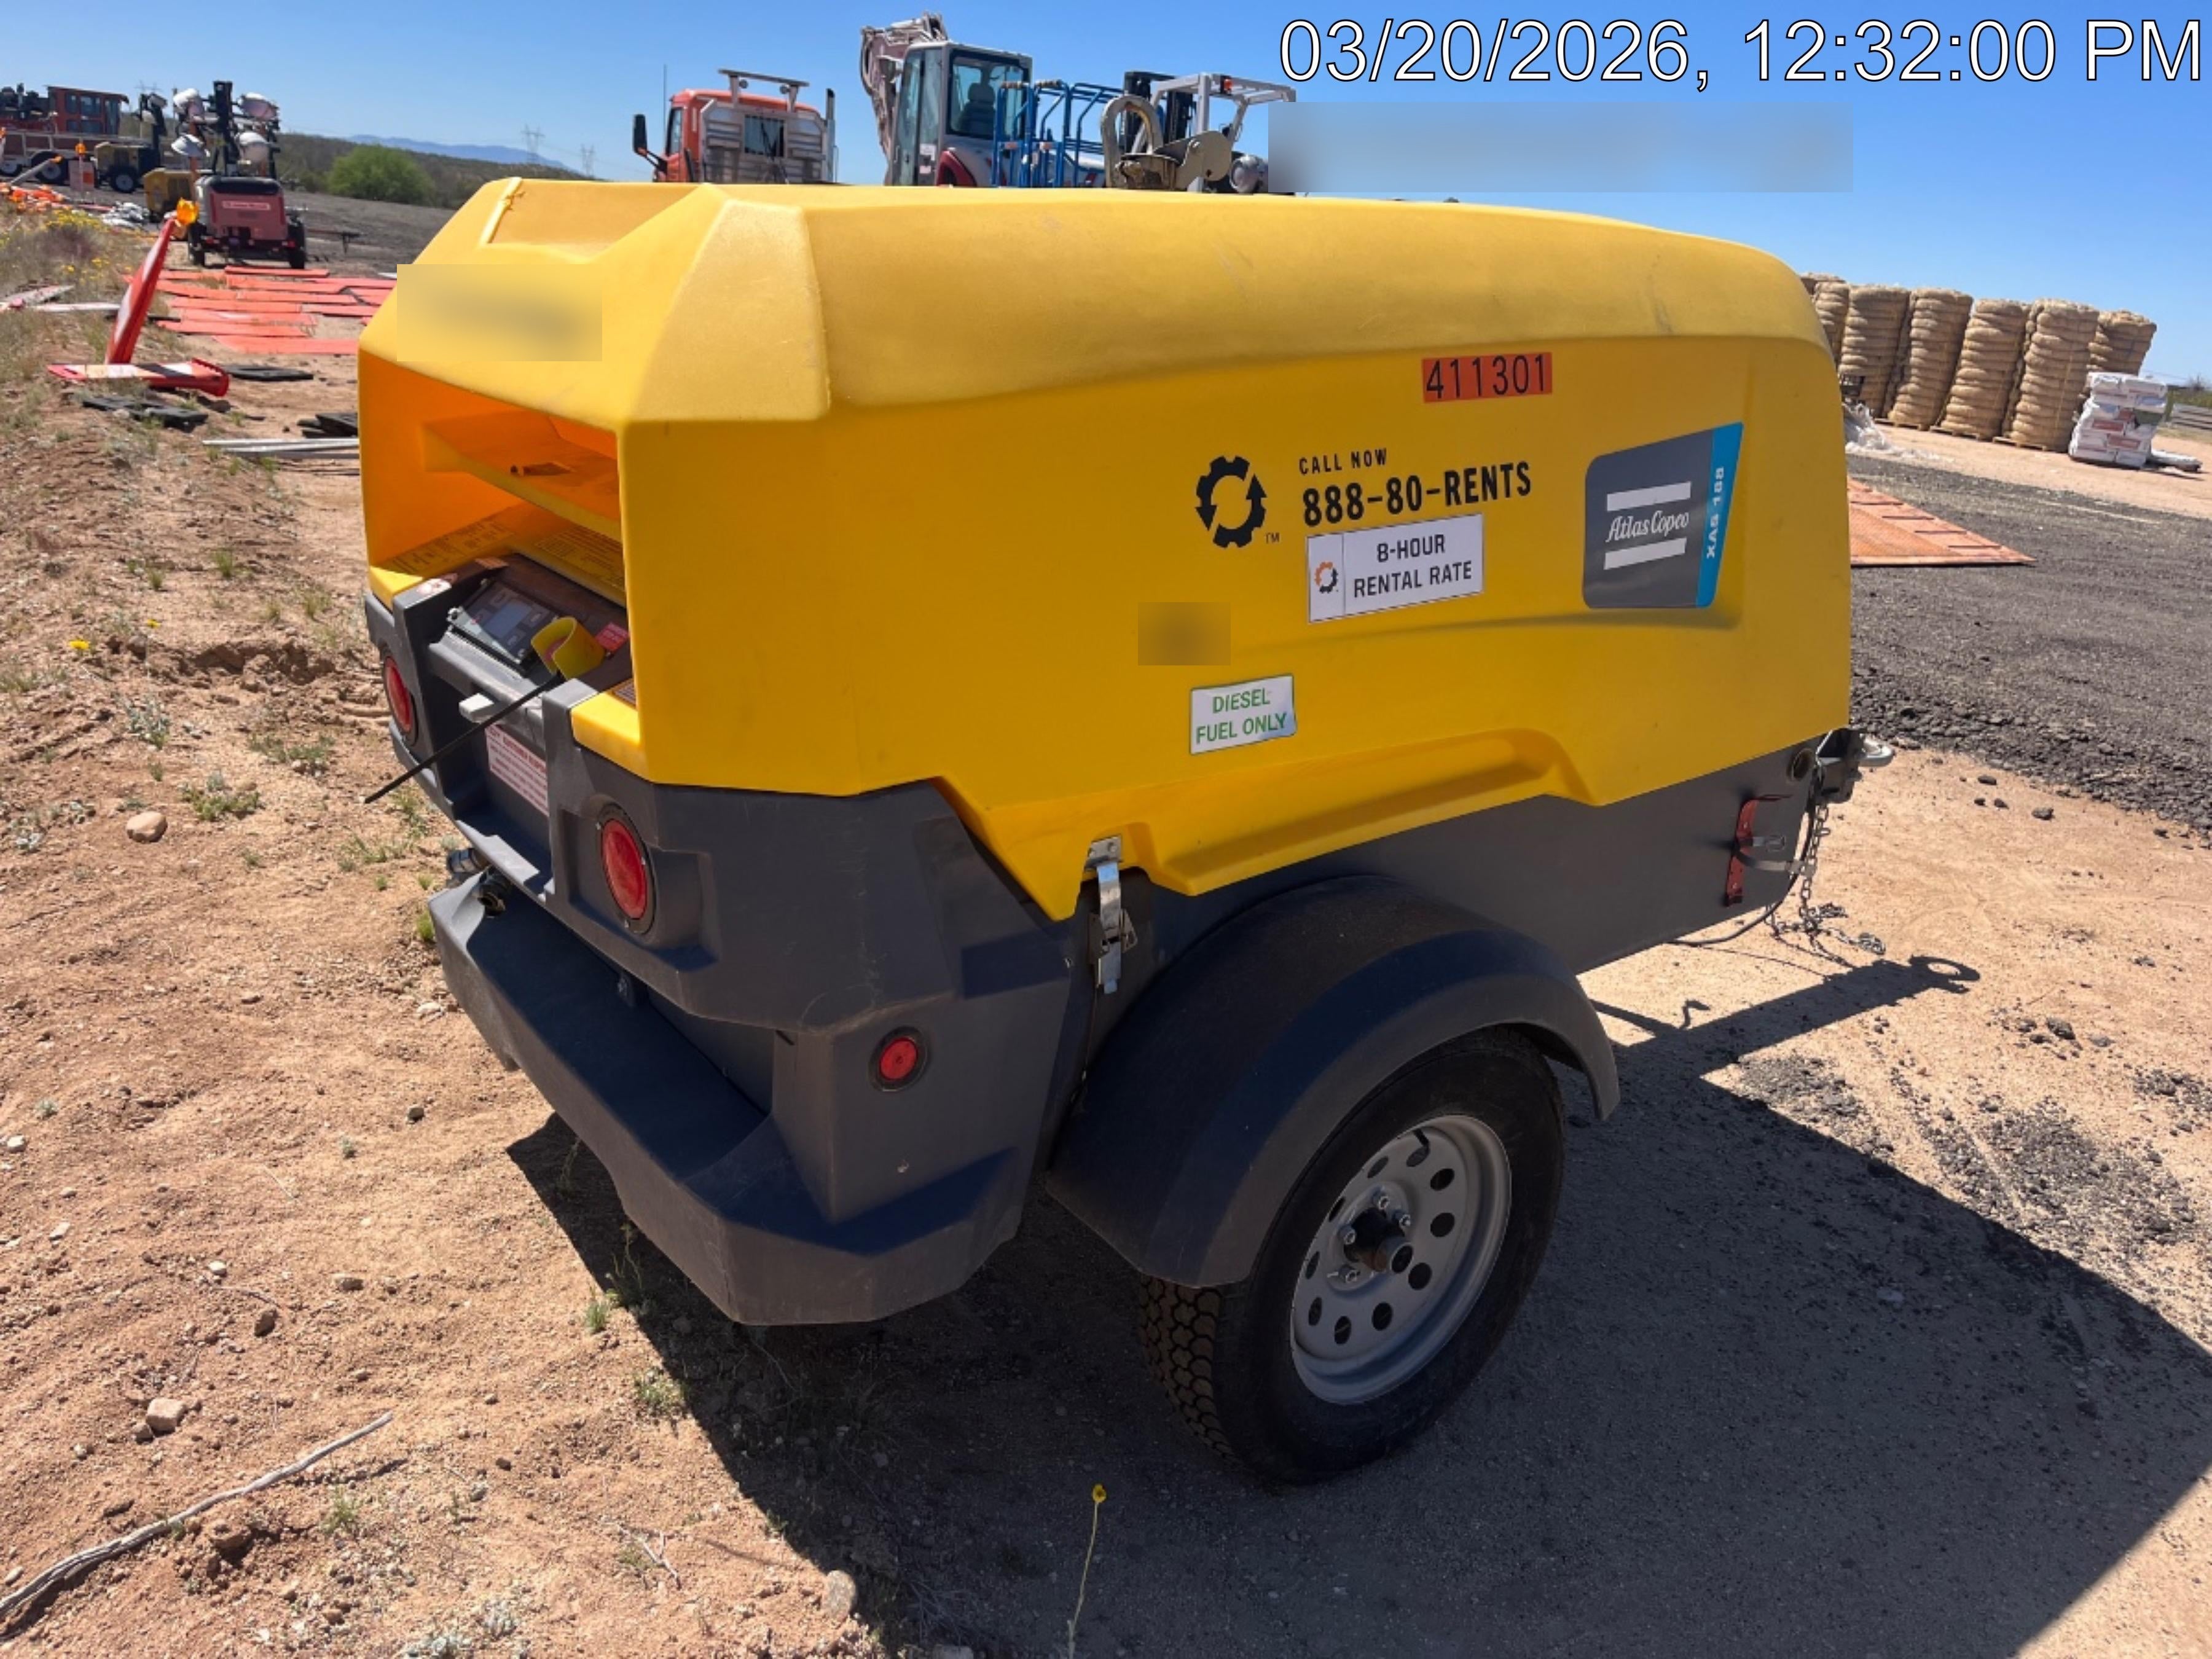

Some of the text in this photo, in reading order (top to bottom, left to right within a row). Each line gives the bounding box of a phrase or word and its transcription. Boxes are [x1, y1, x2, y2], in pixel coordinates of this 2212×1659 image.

[1426, 353, 1545, 399] 411301
[1299, 448, 1387, 474] CALL NOW
[1303, 461, 1531, 527] 888-80-RENTS
[1606, 510, 1689, 543] Atlas Copco
[1706, 513, 1719, 559] XAS
[1376, 533, 1445, 563] 8-HOUR
[1354, 560, 1472, 598] RENTAL RATE
[1212, 688, 1271, 714] DIESEL
[1196, 711, 1287, 745] FUEL ONLY
